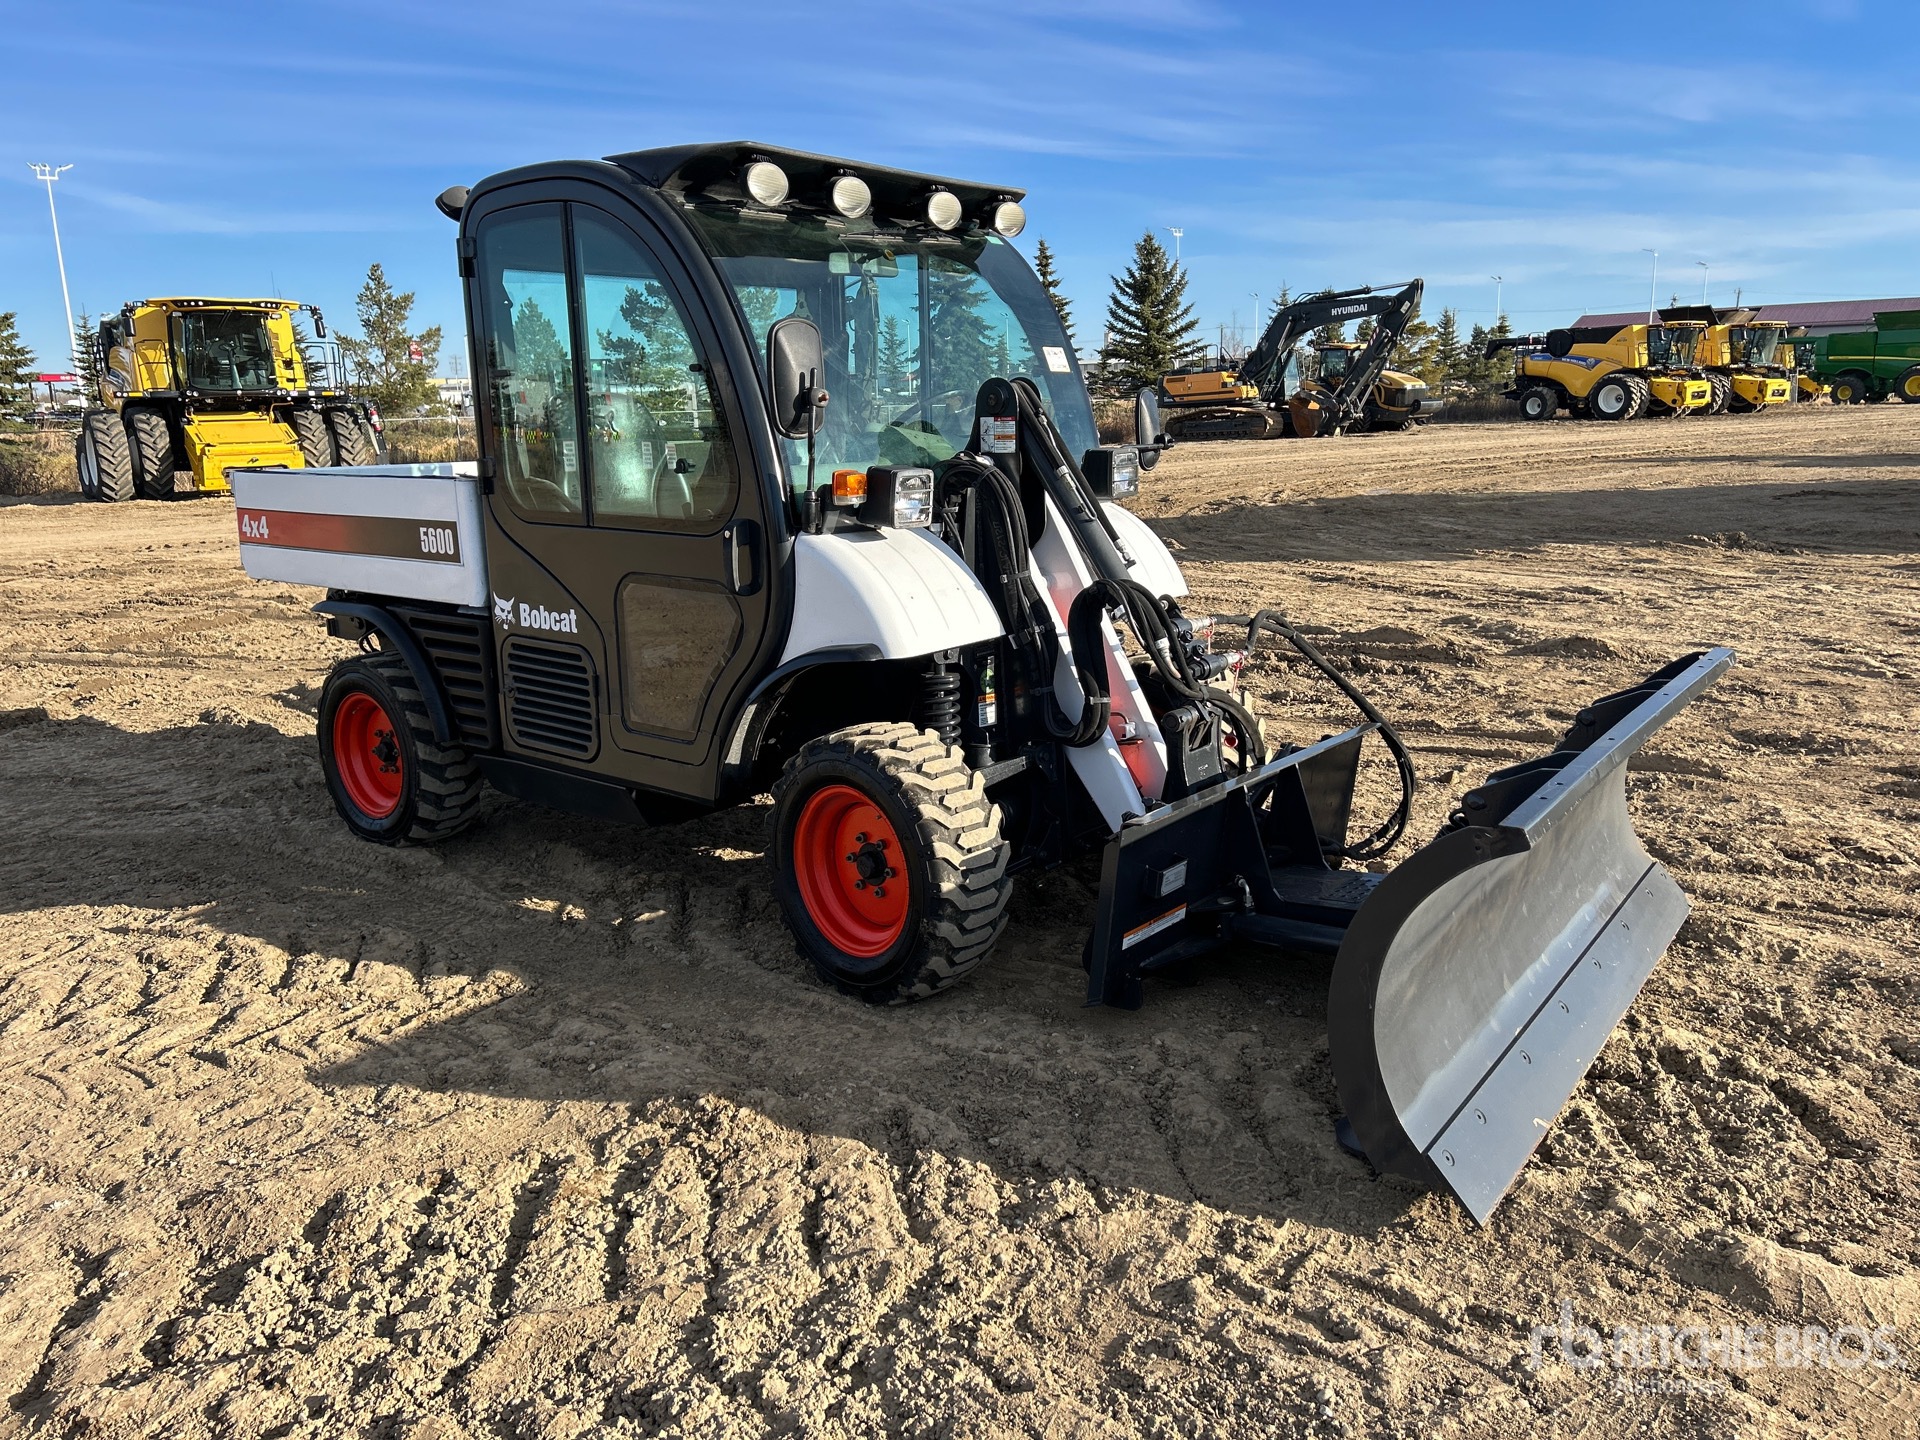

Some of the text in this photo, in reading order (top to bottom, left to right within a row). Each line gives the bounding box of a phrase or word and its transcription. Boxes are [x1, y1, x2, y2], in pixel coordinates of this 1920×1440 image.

[1331, 303, 1367, 316] HYUNDAI
[242, 514, 269, 539] 4x4
[419, 526, 454, 555] 5600
[519, 602, 578, 634] Bobcat
